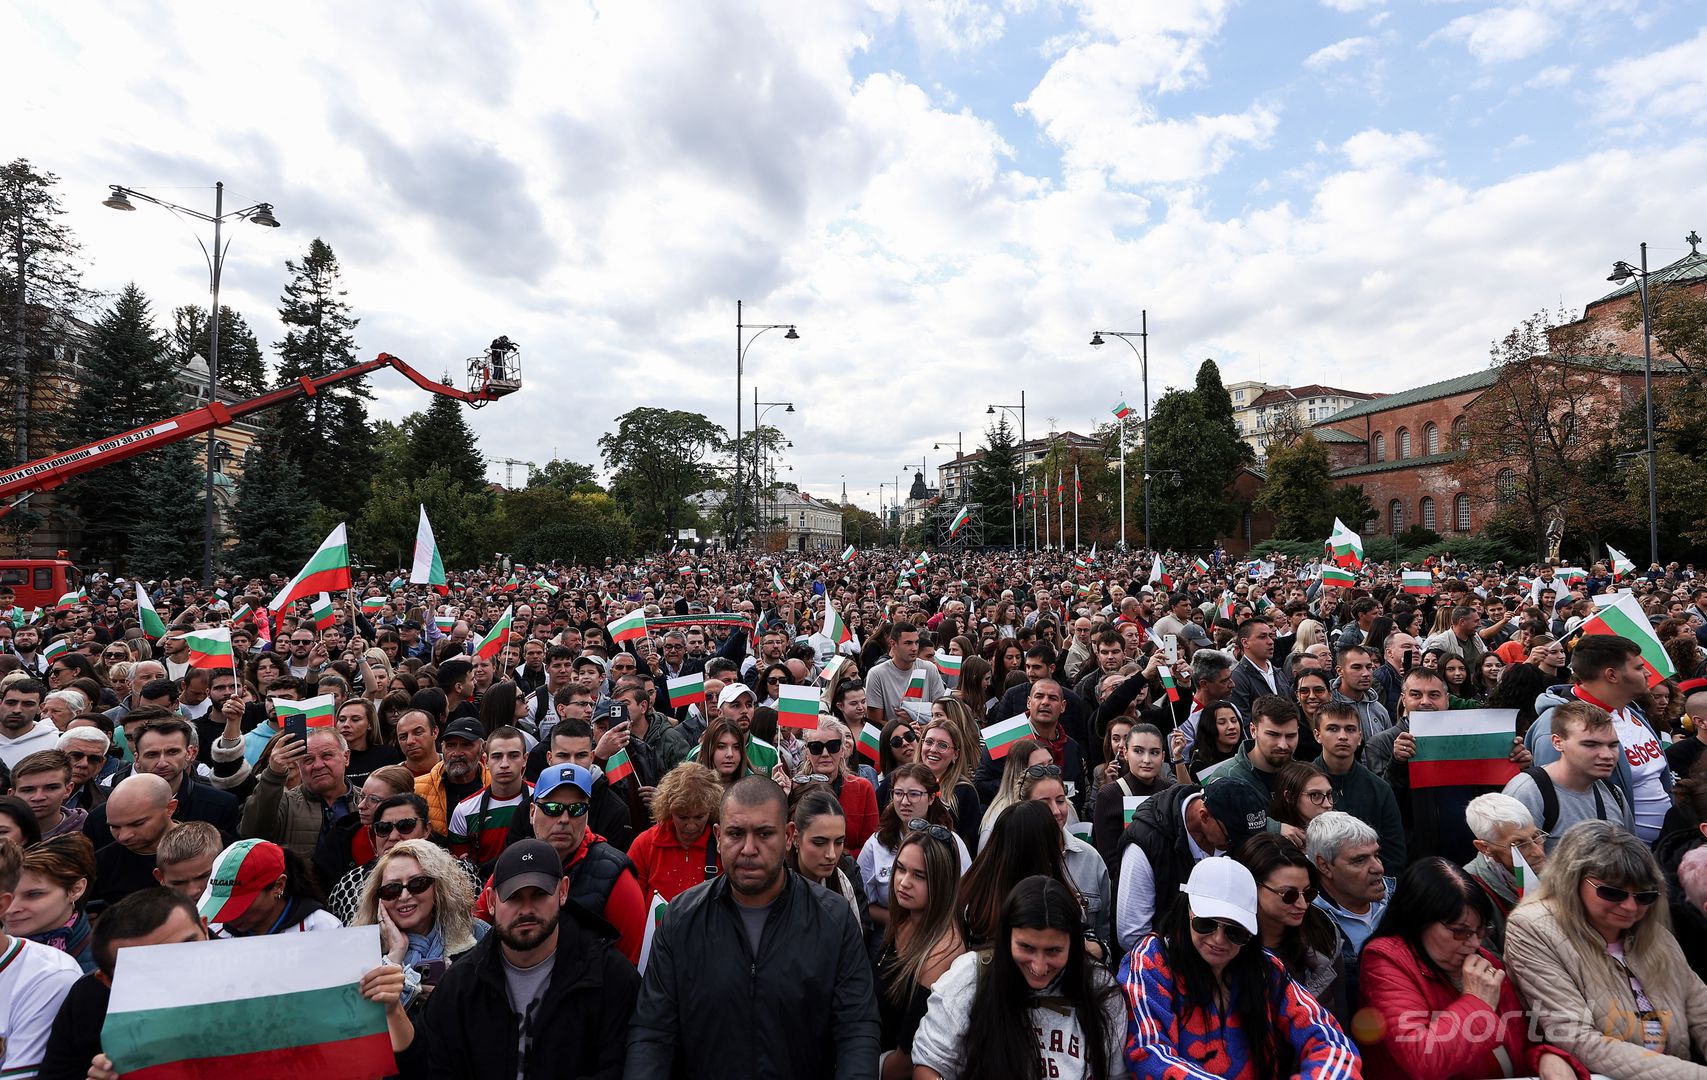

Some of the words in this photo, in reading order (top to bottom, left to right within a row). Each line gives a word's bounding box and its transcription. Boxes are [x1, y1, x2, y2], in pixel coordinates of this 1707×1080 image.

[0, 471, 25, 484] ЛУГИ
[33, 449, 92, 473] АВТОВИШКИ
[97, 440, 121, 452] 0897
[121, 436, 134, 445] 38
[133, 432, 145, 441] 37
[144, 428, 155, 437] 37
[521, 853, 533, 861] ck
